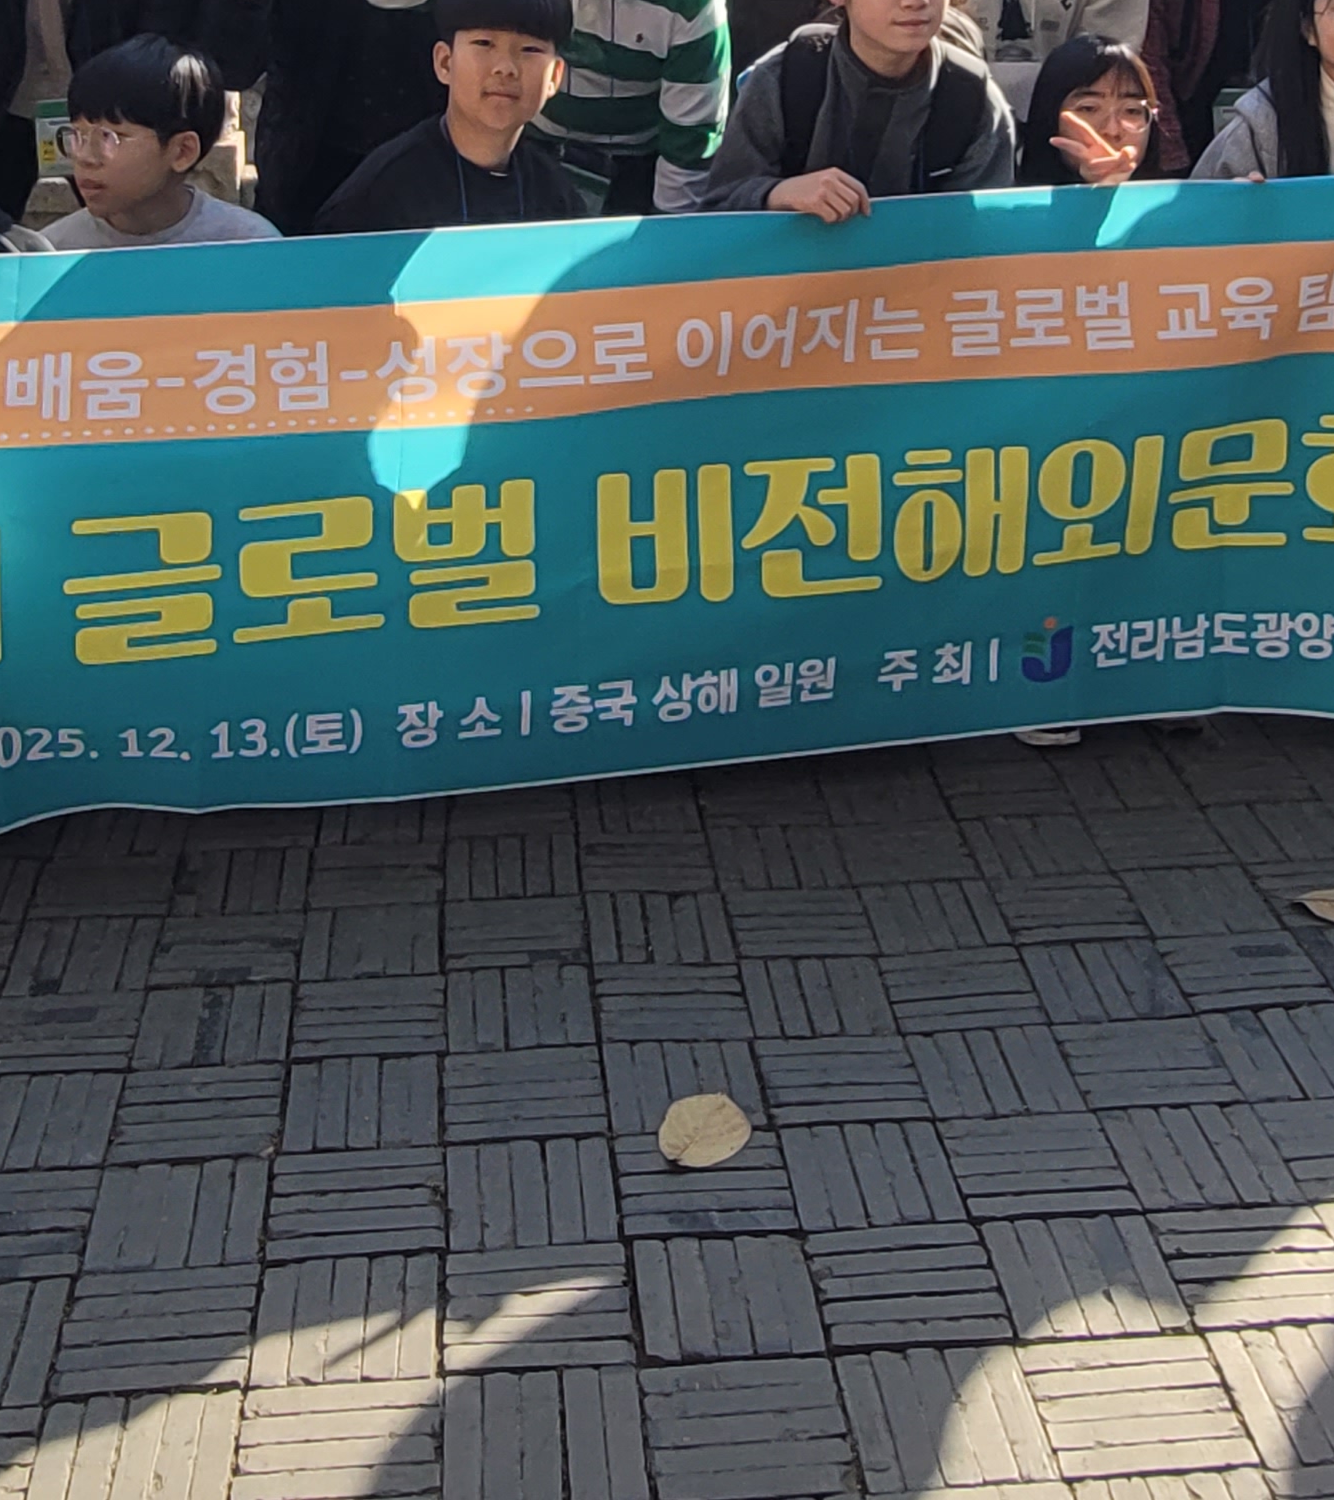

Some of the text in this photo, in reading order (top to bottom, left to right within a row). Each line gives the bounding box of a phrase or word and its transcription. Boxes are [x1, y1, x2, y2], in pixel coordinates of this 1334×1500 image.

[4, 317, 654, 422] 배움-경험-성장으로
[675, 296, 924, 376] 이어지는
[943, 281, 1135, 357] 글로벌
[1157, 277, 1279, 340] 교육
[63, 479, 540, 666] 글로벌
[549, 680, 638, 733] 중국
[651, 667, 740, 723] 상해
[754, 657, 837, 708] 일원
